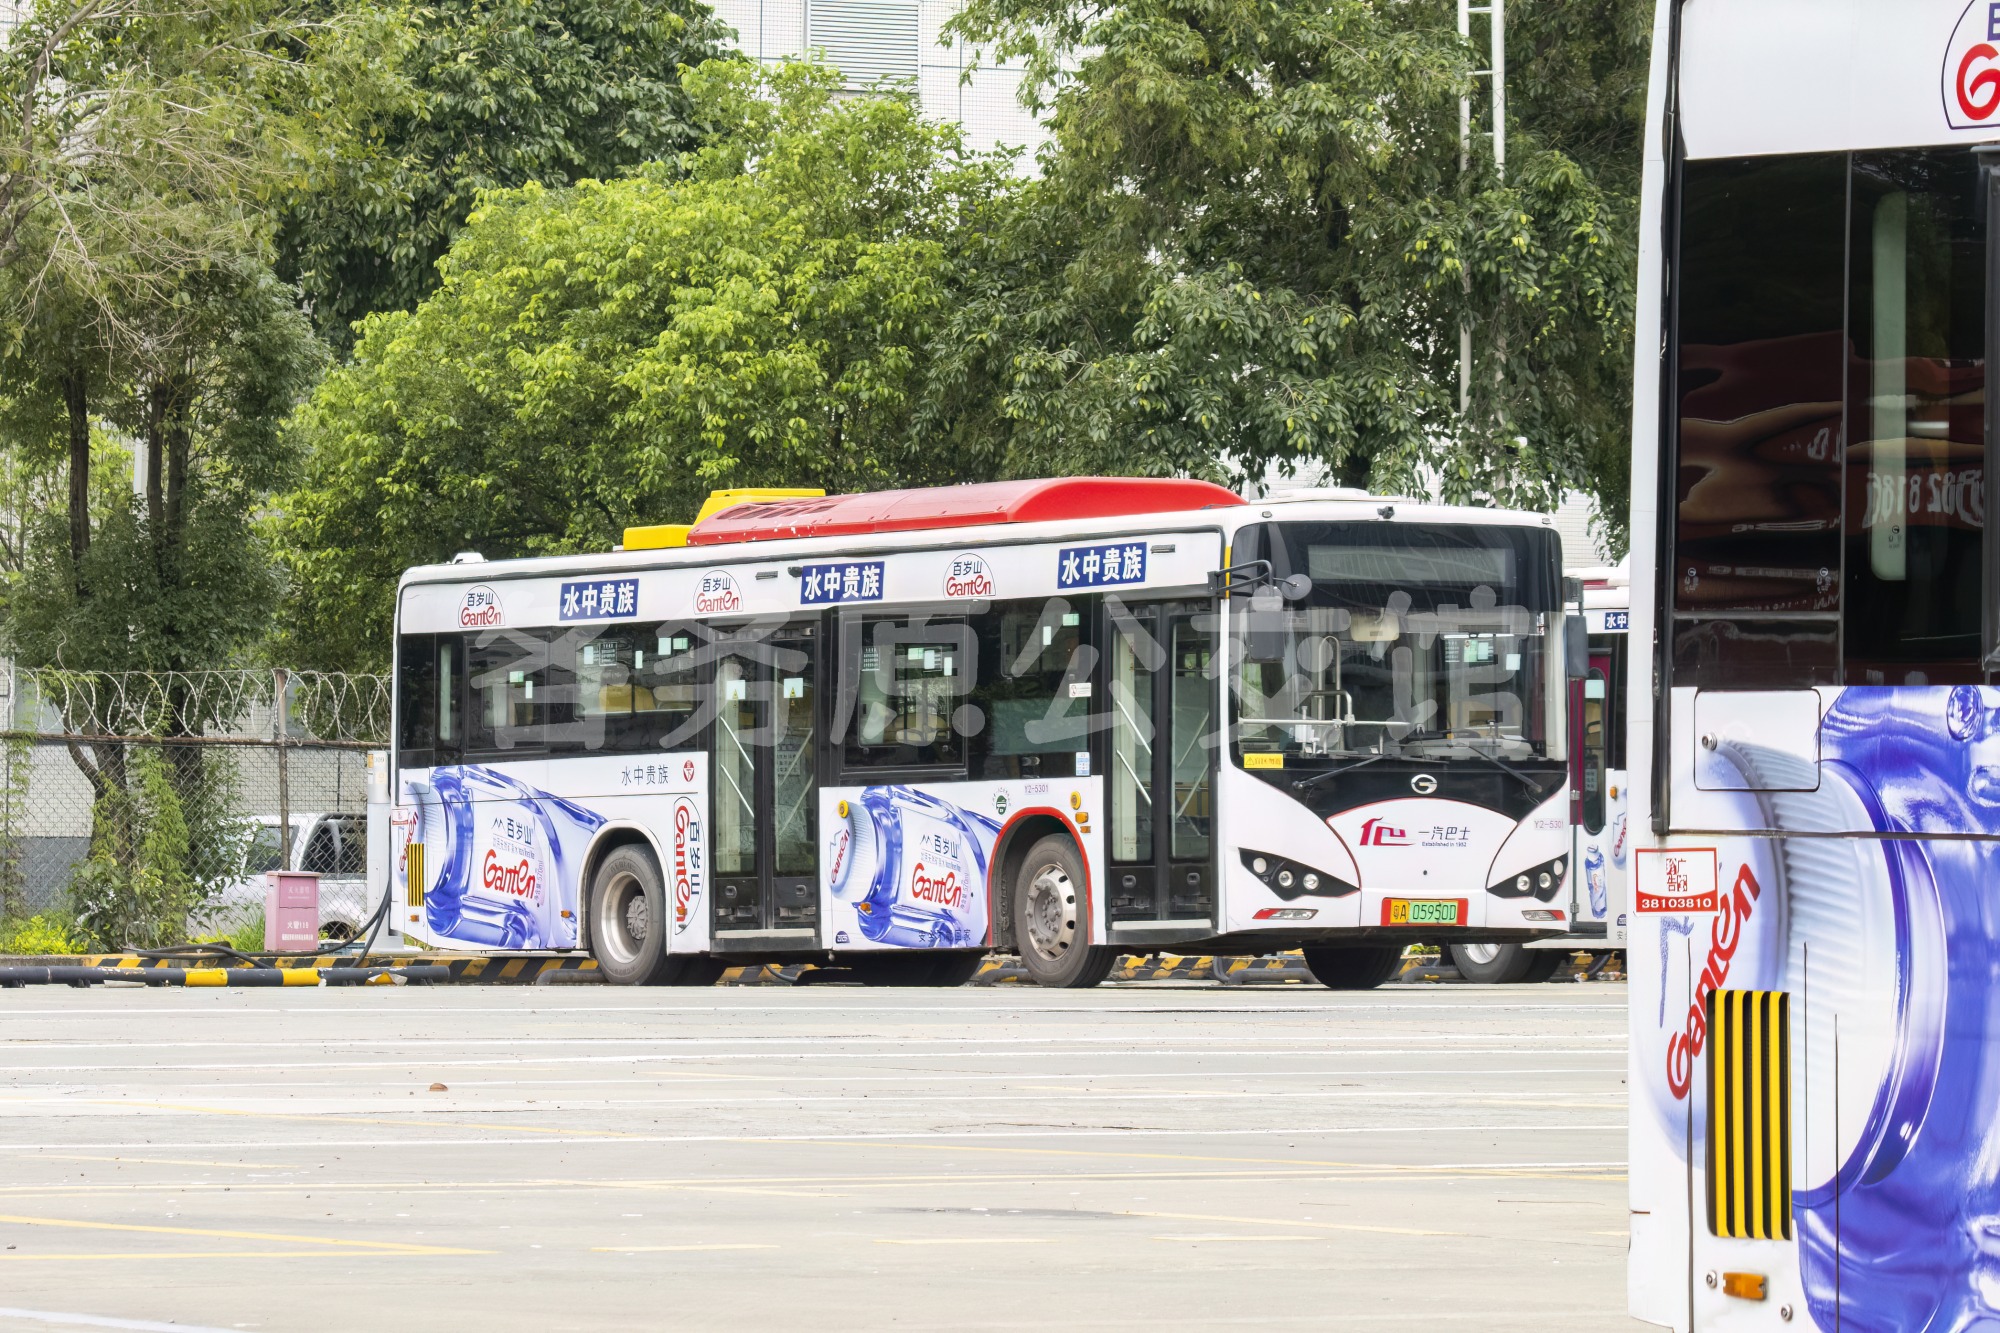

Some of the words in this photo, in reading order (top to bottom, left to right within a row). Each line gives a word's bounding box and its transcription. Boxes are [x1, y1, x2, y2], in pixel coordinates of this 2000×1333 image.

[953, 561, 982, 576] 百岁山
[1062, 546, 1142, 585] 水中贵族
[703, 578, 731, 592] 百岁山
[804, 565, 880, 600] 水中贵族
[946, 575, 991, 596] Ganten
[467, 593, 494, 607] 百岁山
[563, 583, 634, 617] 水中贵族
[697, 591, 739, 612] Ganten
[461, 606, 502, 626] Ganten
[1606, 613, 1629, 629] 水中
[621, 765, 669, 786] 水中贵族
[506, 817, 532, 846] 百岁山
[1418, 826, 1471, 840] 一汽巴士
[934, 834, 958, 859] 百岁山
[689, 821, 701, 895] 百岁山
[483, 849, 536, 899] Ganten
[911, 862, 962, 908] Ganten
[1641, 898, 1712, 909] 38103810
